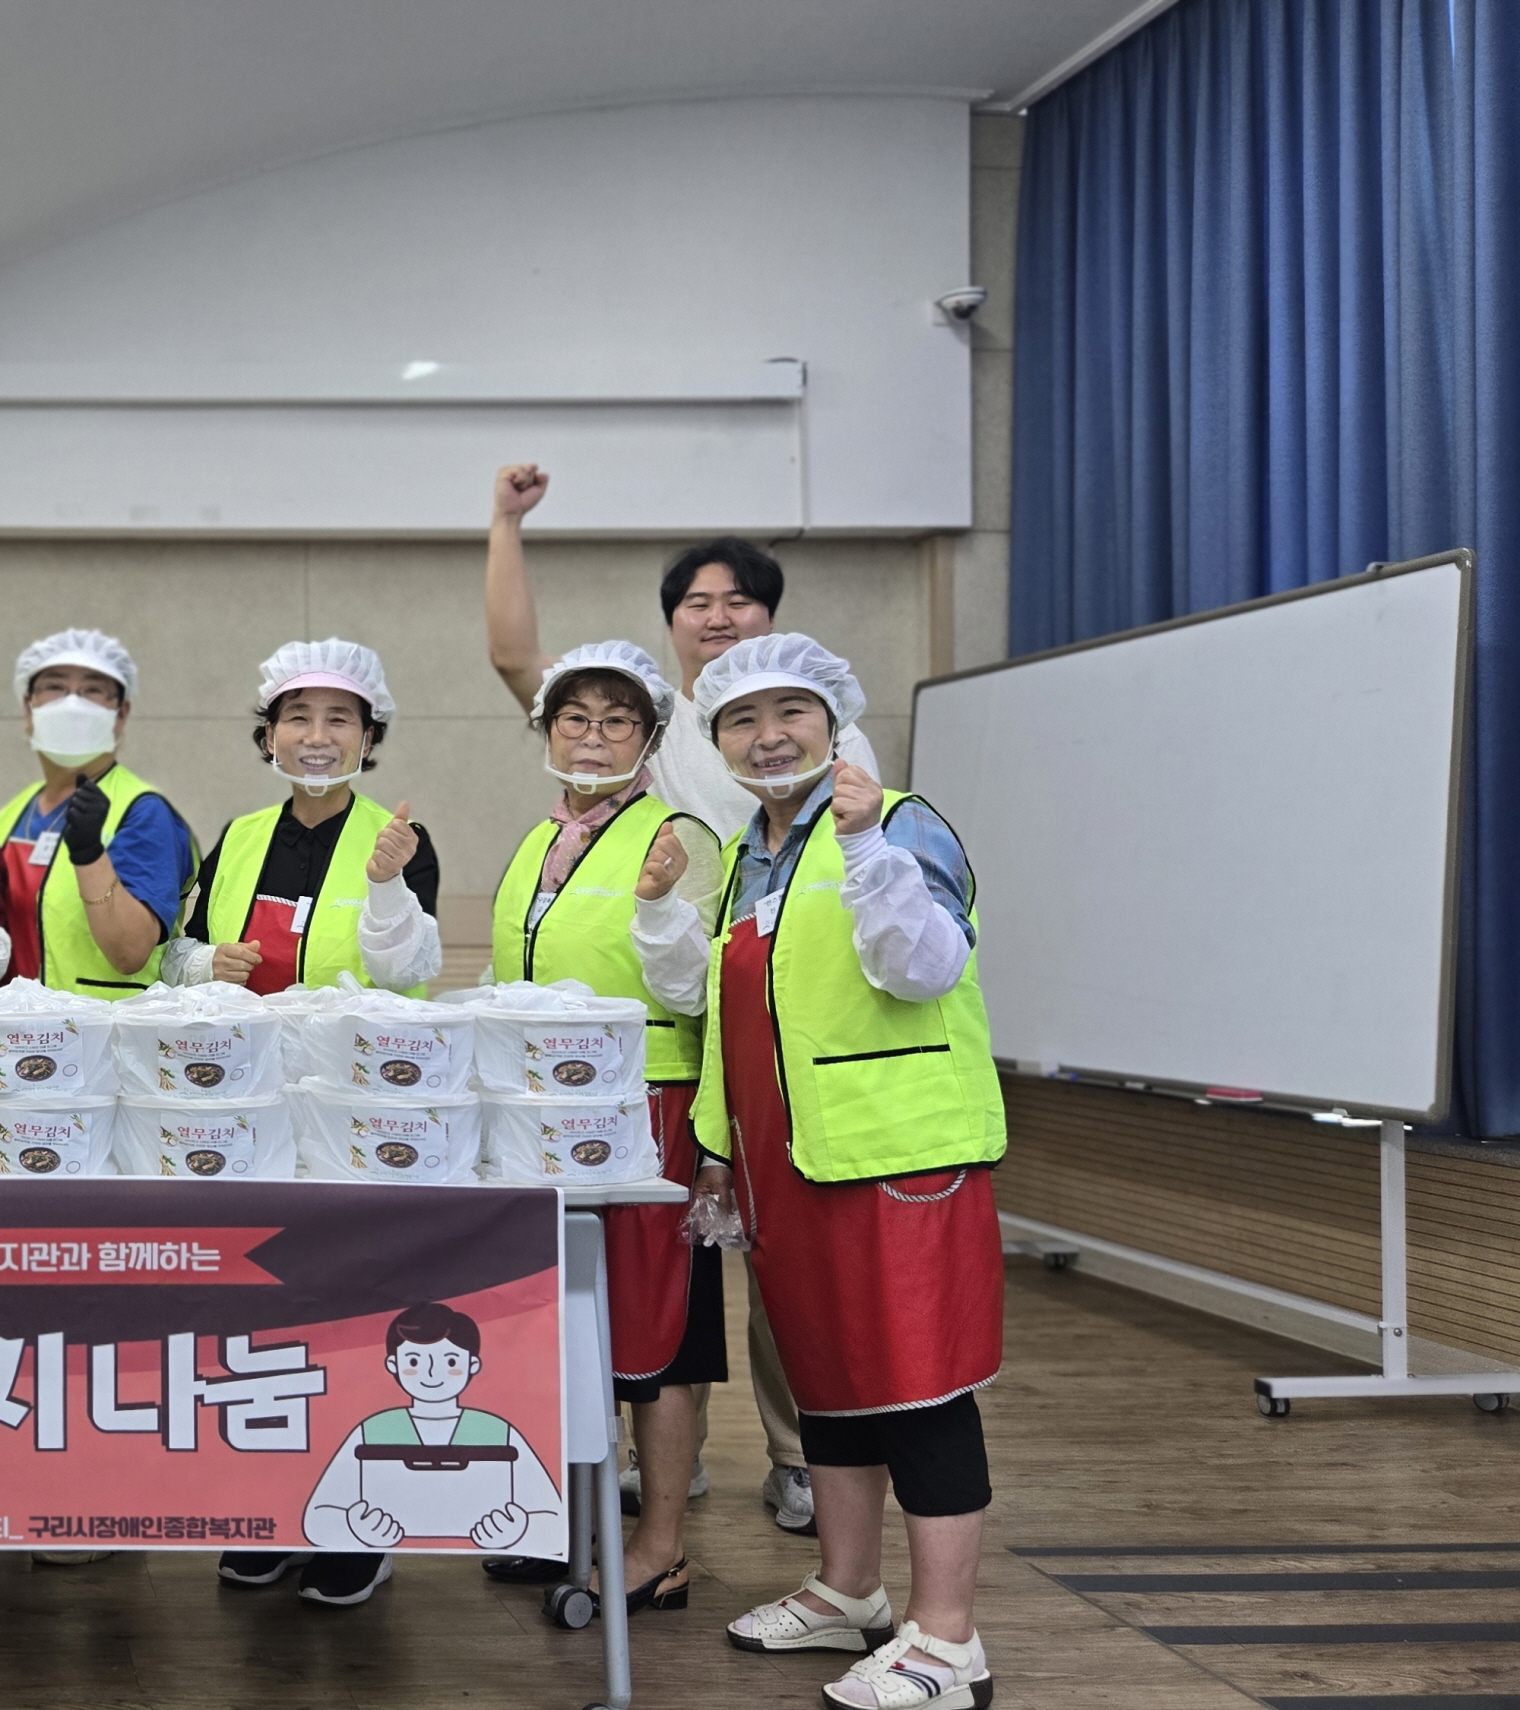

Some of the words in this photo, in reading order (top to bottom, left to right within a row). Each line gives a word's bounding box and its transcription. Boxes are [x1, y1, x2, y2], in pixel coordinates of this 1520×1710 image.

[6, 1031, 64, 1047] 열무김치
[174, 1038, 232, 1054] 열무김치
[376, 1035, 433, 1054] 열무김치
[542, 1036, 603, 1050] 열무김치
[13, 1122, 71, 1139] 열무김치
[368, 1117, 427, 1133] 열무김치
[561, 1114, 618, 1132] 열무김치
[177, 1126, 235, 1140] 열무김치
[97, 1240, 221, 1273] 함께하는
[90, 1330, 328, 1453] 나눔
[27, 1515, 277, 1541] 구리시장애인종합복지관
